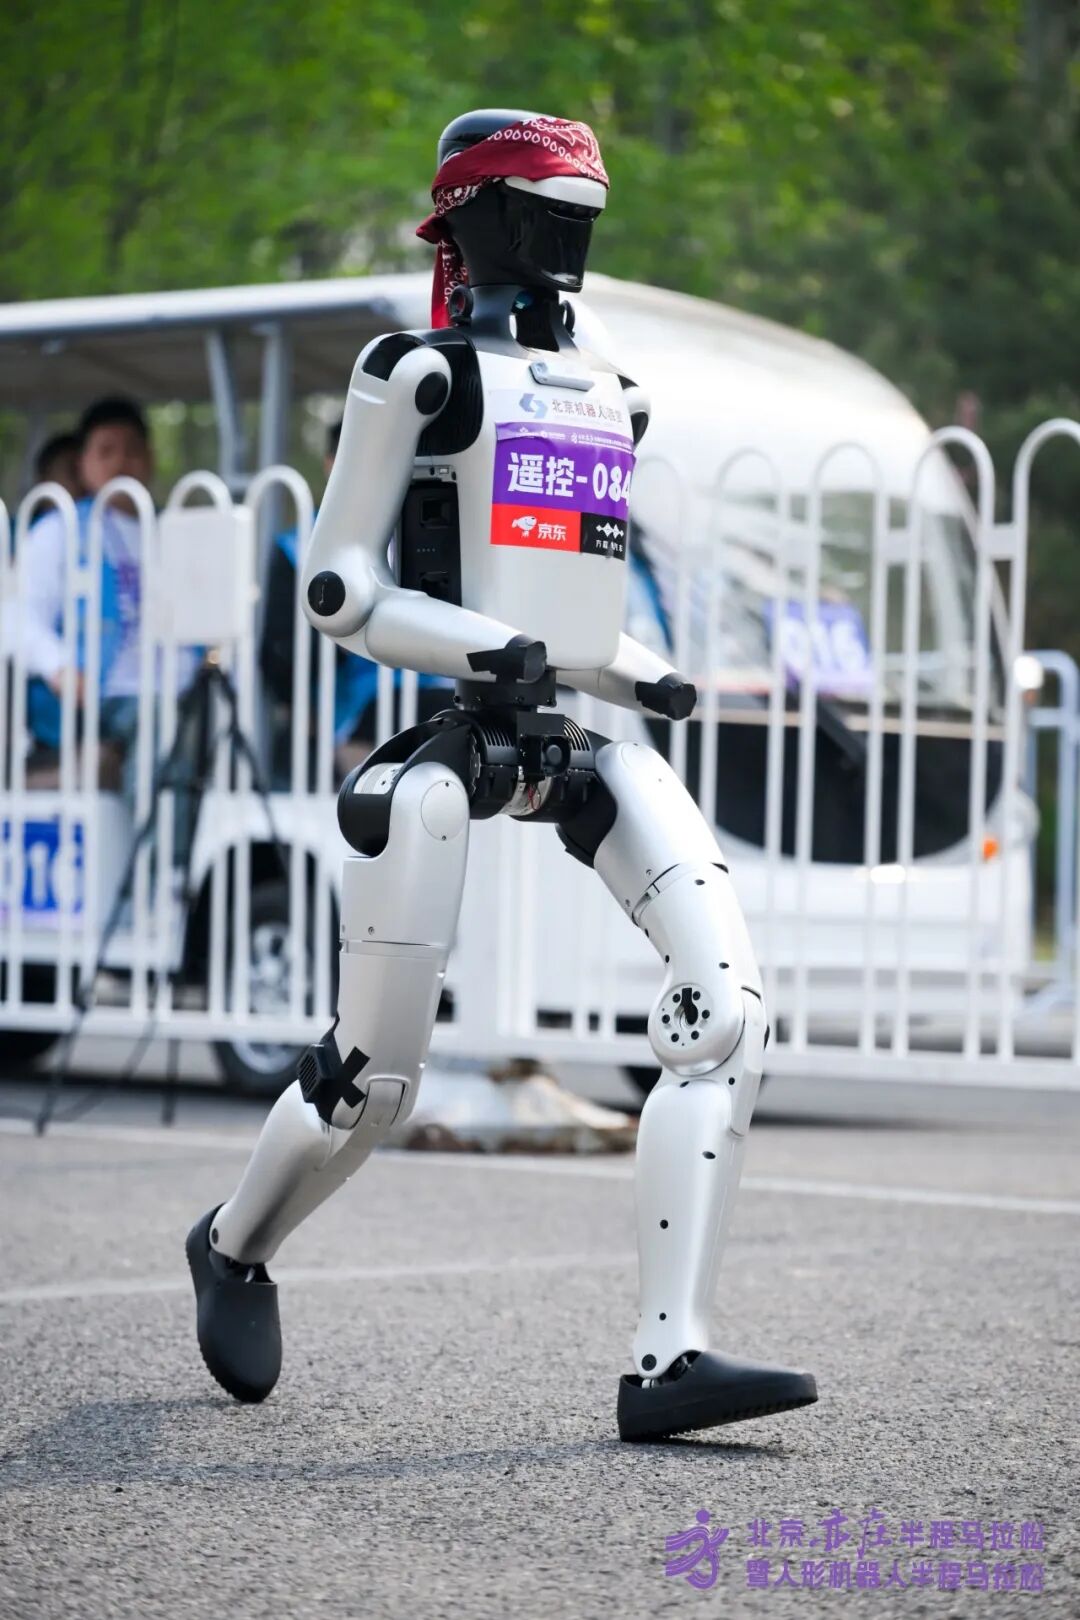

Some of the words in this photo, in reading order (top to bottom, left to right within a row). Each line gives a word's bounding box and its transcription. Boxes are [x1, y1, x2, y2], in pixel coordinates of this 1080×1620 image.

[551, 399, 625, 423] 北京机器人
[507, 452, 632, 507] 遥控-084
[537, 523, 567, 541] 京东
